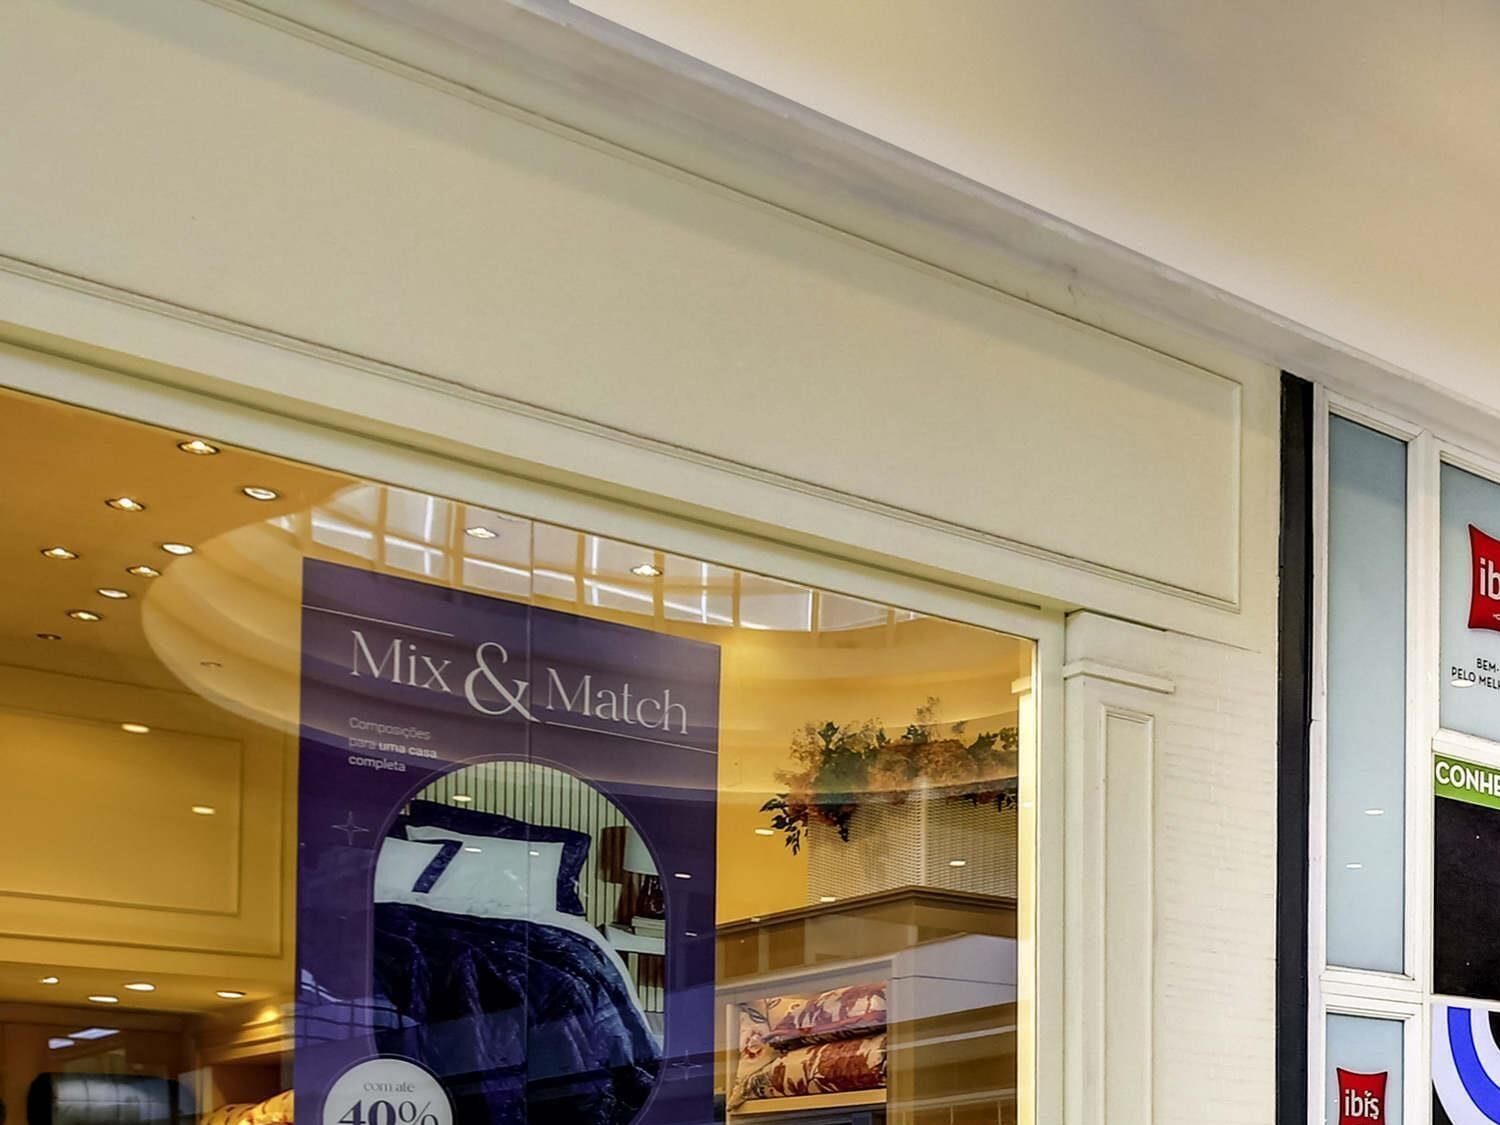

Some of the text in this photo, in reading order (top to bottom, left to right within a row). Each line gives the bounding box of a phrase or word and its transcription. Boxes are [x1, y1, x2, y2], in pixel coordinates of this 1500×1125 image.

[350, 630, 688, 734] Mix & Match
[1451, 666, 1477, 682] PELO
[349, 717, 431, 740] Composições
[379, 742, 406, 754] uma
[408, 746, 437, 758] casa
[348, 756, 406, 772] completa
[363, 1082, 392, 1092] com
[1345, 1089, 1380, 1120] ibis
